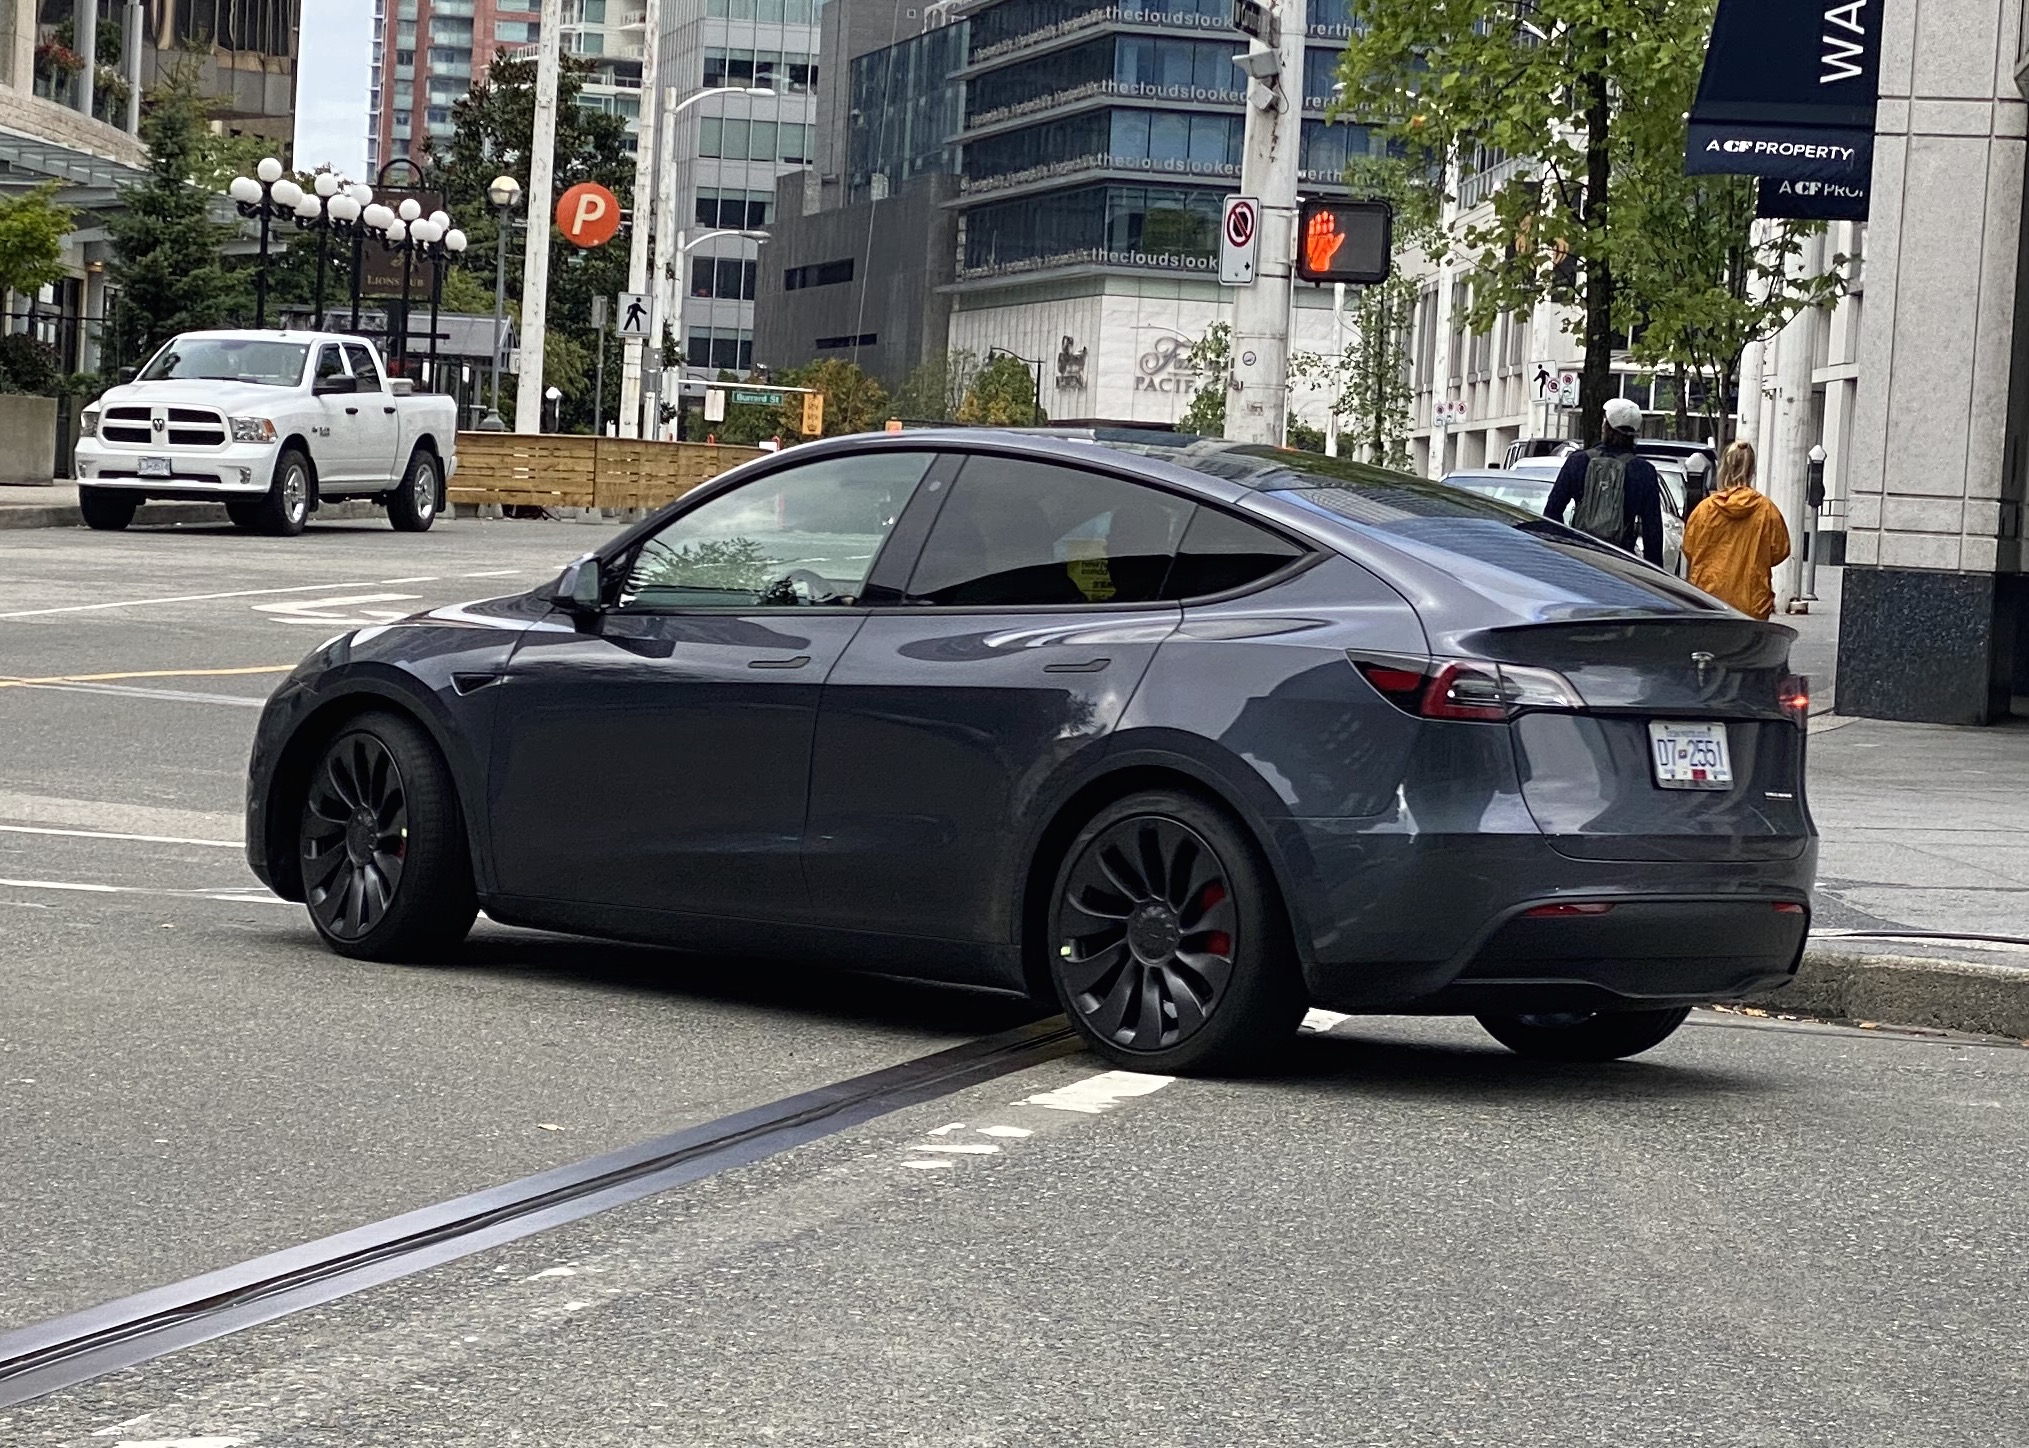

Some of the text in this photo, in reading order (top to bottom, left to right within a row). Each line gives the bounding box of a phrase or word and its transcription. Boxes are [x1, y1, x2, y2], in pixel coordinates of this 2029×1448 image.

[1820, 0, 1867, 83] WA
[1706, 140, 1854, 160] A CF PROPERTY
[1779, 180, 1792, 194] A
[1795, 181, 1822, 195] CF
[572, 193, 606, 235] P
[1092, 247, 1218, 269] thecloudslook
[1134, 376, 1198, 394] PACIF
[770, 395, 779, 404] St
[1687, 740, 1724, 767] 2551
